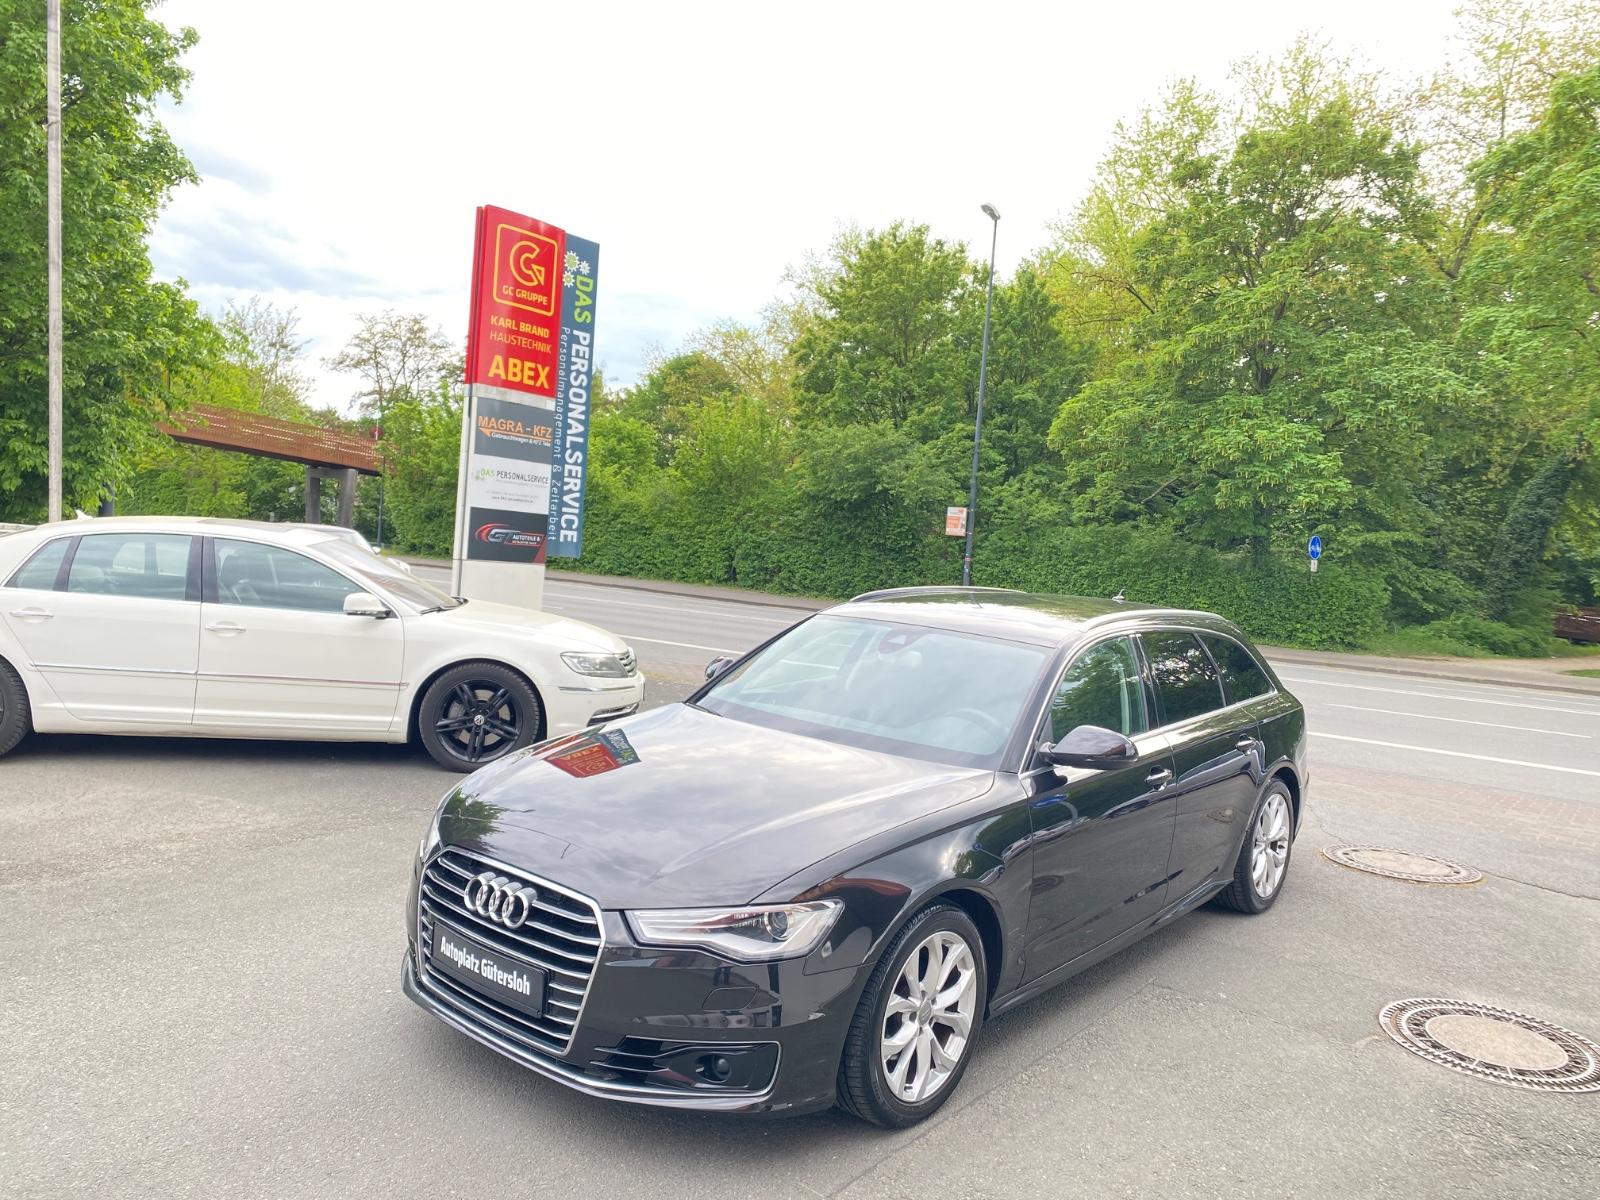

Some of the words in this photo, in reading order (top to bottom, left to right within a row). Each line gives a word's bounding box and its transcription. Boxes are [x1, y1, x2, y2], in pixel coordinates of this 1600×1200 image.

[502, 285, 514, 296] GC
[515, 287, 548, 306] GRUPPE
[573, 274, 594, 324] DAS
[490, 315, 518, 331] KARL
[519, 321, 550, 339] BRAND
[489, 330, 552, 354] HAUSTECHNIK
[488, 354, 551, 389] ABEX
[553, 327, 571, 458] Personalmanagement
[478, 415, 523, 433] MAGRA
[533, 424, 553, 438] KFZ
[560, 329, 591, 543] PERSONALSERVICE
[480, 468, 495, 477] DAS
[496, 470, 549, 485] PERSONALSERVICE
[552, 464, 562, 473] &
[548, 480, 561, 540] Zeitarbeit
[440, 936, 480, 974] Autoplatz
[480, 958, 530, 996] Gütersloh
